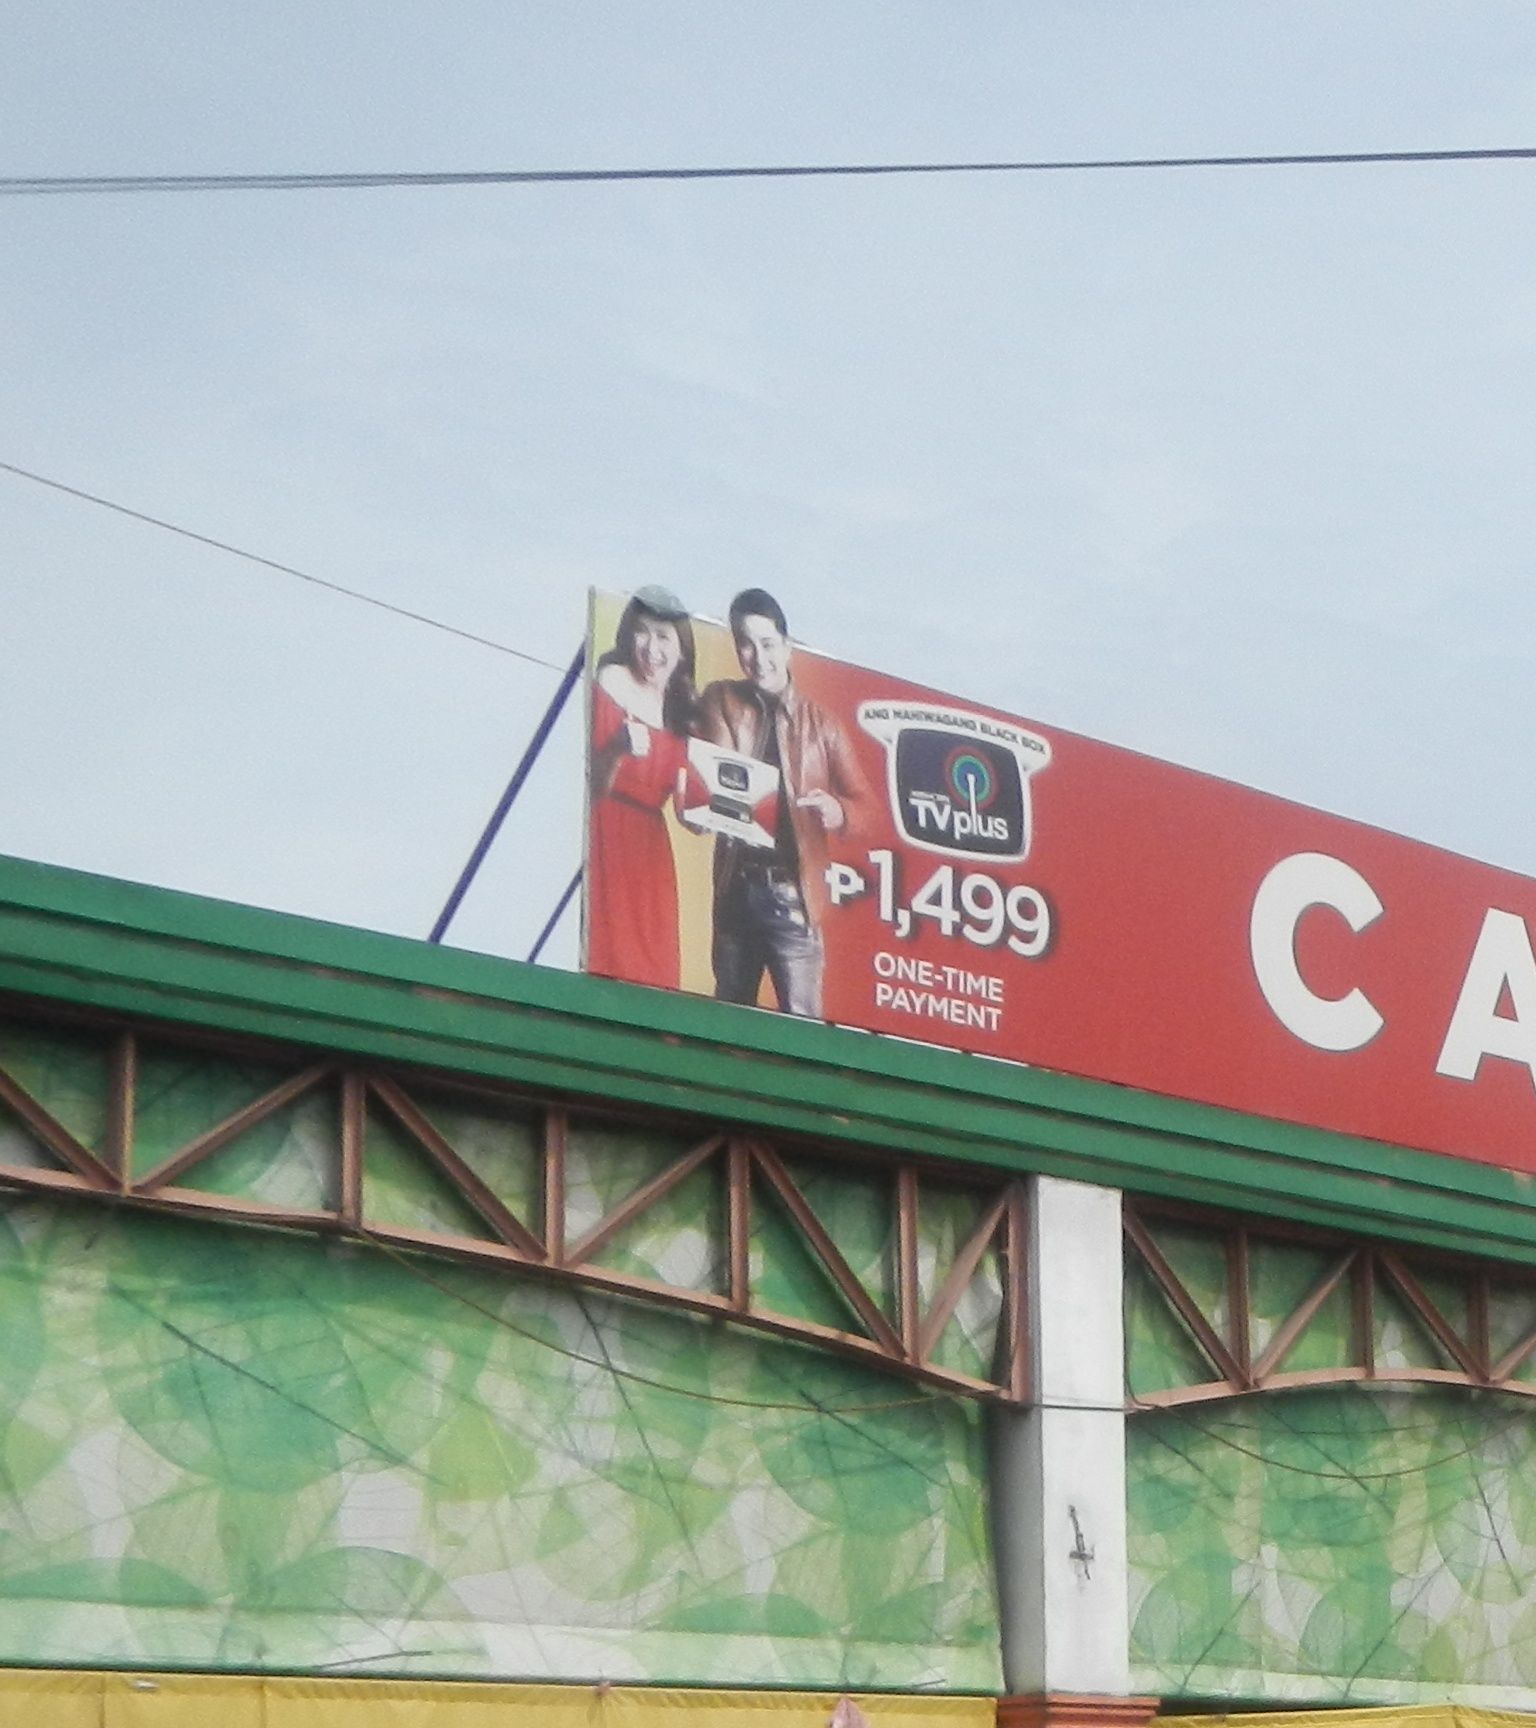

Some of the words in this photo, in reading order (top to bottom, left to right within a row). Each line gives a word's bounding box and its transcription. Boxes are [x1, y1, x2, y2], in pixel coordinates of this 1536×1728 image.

[981, 723, 1020, 745] BLACK
[874, 952, 1004, 1003] ONE-TIME
[875, 983, 1003, 1032] PAYMENT
